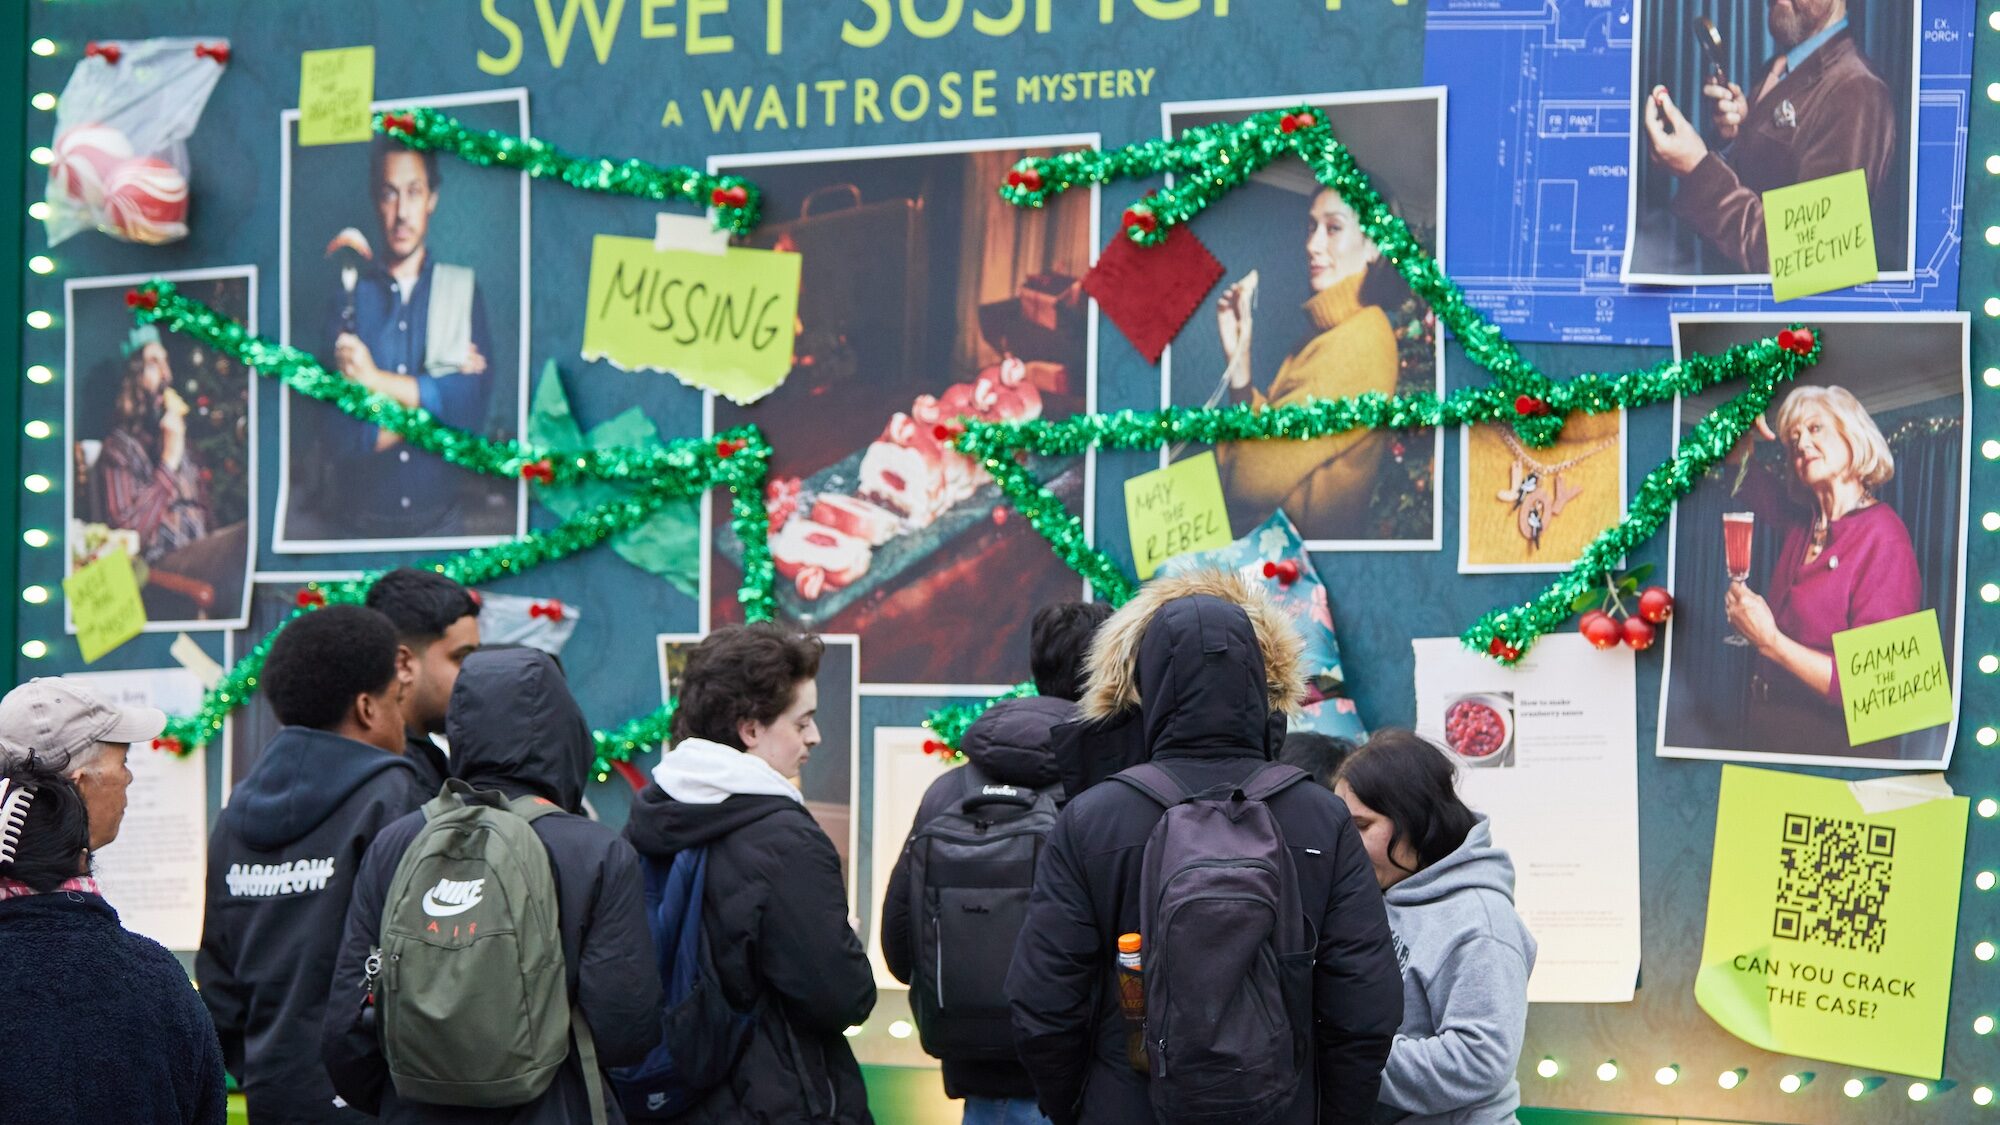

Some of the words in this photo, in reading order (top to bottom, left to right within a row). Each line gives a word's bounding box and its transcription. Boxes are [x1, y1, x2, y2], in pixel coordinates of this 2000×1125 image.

[1924, 30, 1959, 42] PORCH
[662, 101, 683, 127] A
[702, 71, 998, 131] WAITROSE
[1016, 69, 1156, 102] MYSTERY
[1588, 165, 1628, 177] KITCHEN
[1784, 196, 1831, 231] DAVID
[1774, 223, 1867, 278] DETECTIVE
[1796, 225, 1816, 244] THE
[600, 259, 780, 351] MISSING
[1135, 478, 1174, 517] MAY
[1146, 509, 1219, 563] REBEL
[1851, 635, 1920, 676] GAMMA
[1853, 660, 1942, 722] MATRIARCH
[1875, 670, 1896, 685] THE
[432, 878, 485, 906] NIKE
[426, 920, 478, 938] AIR
[1733, 954, 1779, 976] CAN
[1790, 963, 1833, 984] YOU
[1843, 971, 1916, 998] CRACK
[1766, 985, 1807, 1008] THE
[1816, 994, 1878, 1019] CASE?
